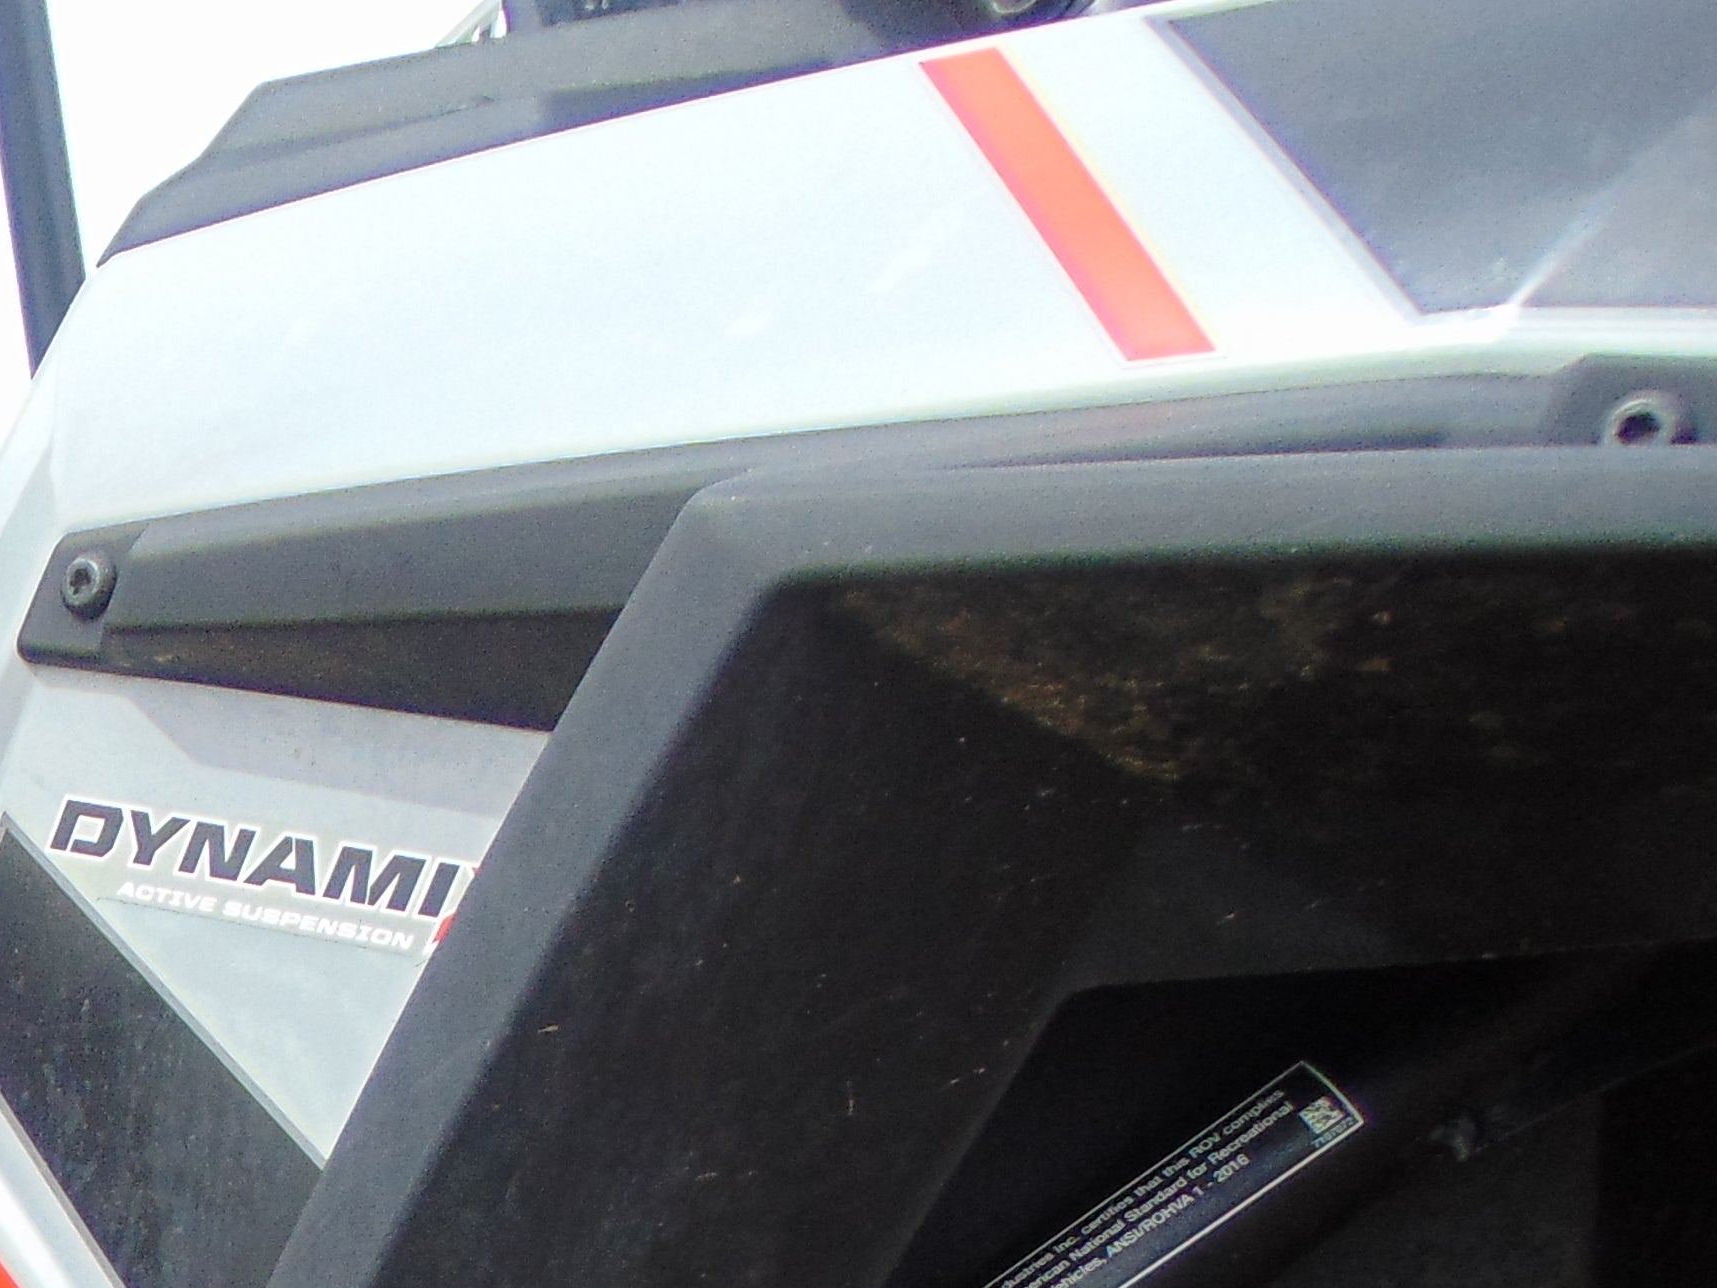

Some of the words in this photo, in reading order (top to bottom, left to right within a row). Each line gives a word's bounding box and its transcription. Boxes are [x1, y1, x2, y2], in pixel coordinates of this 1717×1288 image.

[48, 795, 475, 928] DYNAMI
[116, 878, 218, 913] ACTIVE
[221, 895, 415, 951] SUSPENSION
[1052, 1236, 1080, 1253] Inc.
[1081, 1196, 1133, 1234] certifies
[1133, 1175, 1163, 1196] that
[1161, 1157, 1190, 1176] this
[1188, 1132, 1220, 1158] ROV
[1222, 1090, 1283, 1134] complies
[1068, 1219, 1125, 1260] National
[1124, 1176, 1187, 1221] Standard
[1186, 1162, 1207, 1179] for
[1207, 1102, 1292, 1164] Recreational
[1213, 1153, 1249, 1182] 2016
